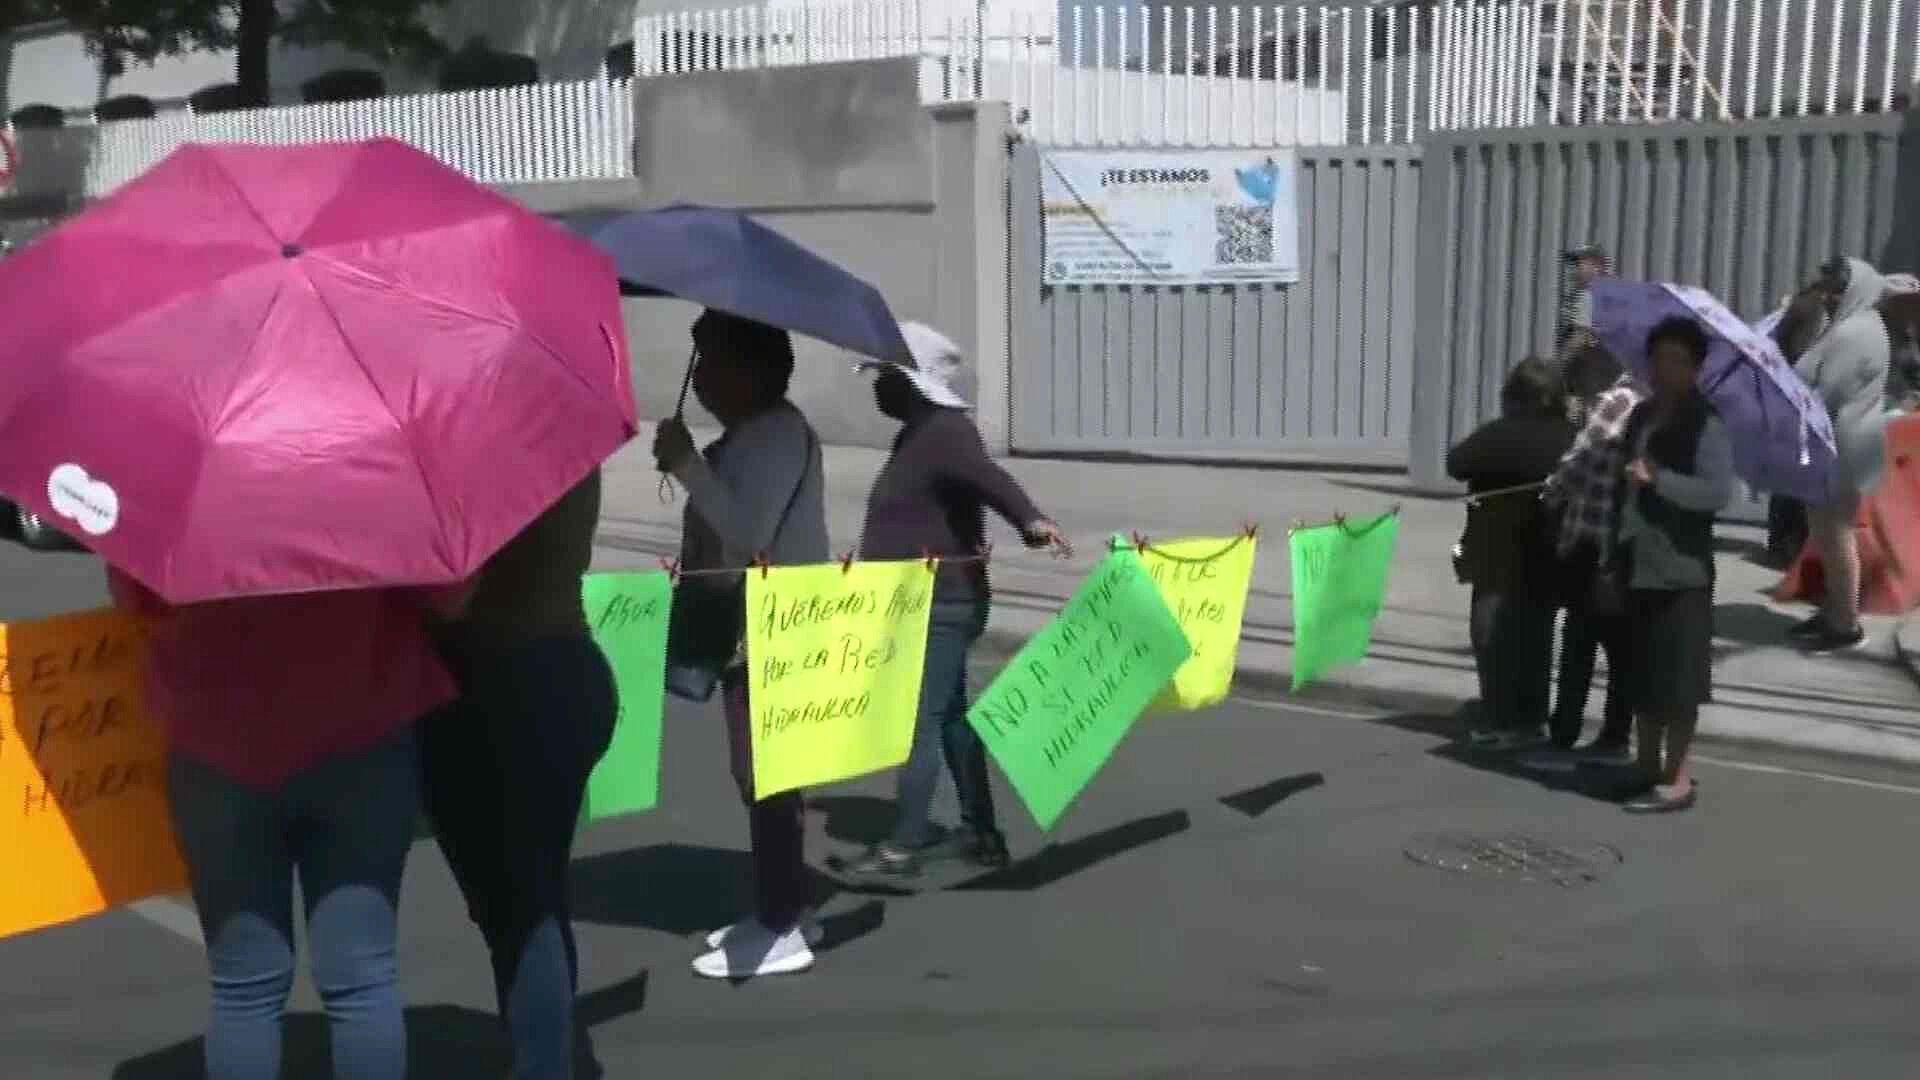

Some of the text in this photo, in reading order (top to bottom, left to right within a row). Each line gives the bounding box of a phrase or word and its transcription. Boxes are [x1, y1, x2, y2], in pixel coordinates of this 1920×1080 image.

[1129, 168, 1210, 184] ESTAMOS
[759, 590, 877, 640] QUEREMOS
[802, 648, 830, 671] LA
[839, 631, 898, 675] RED
[978, 686, 1028, 740] NO
[1029, 660, 1052, 688] A
